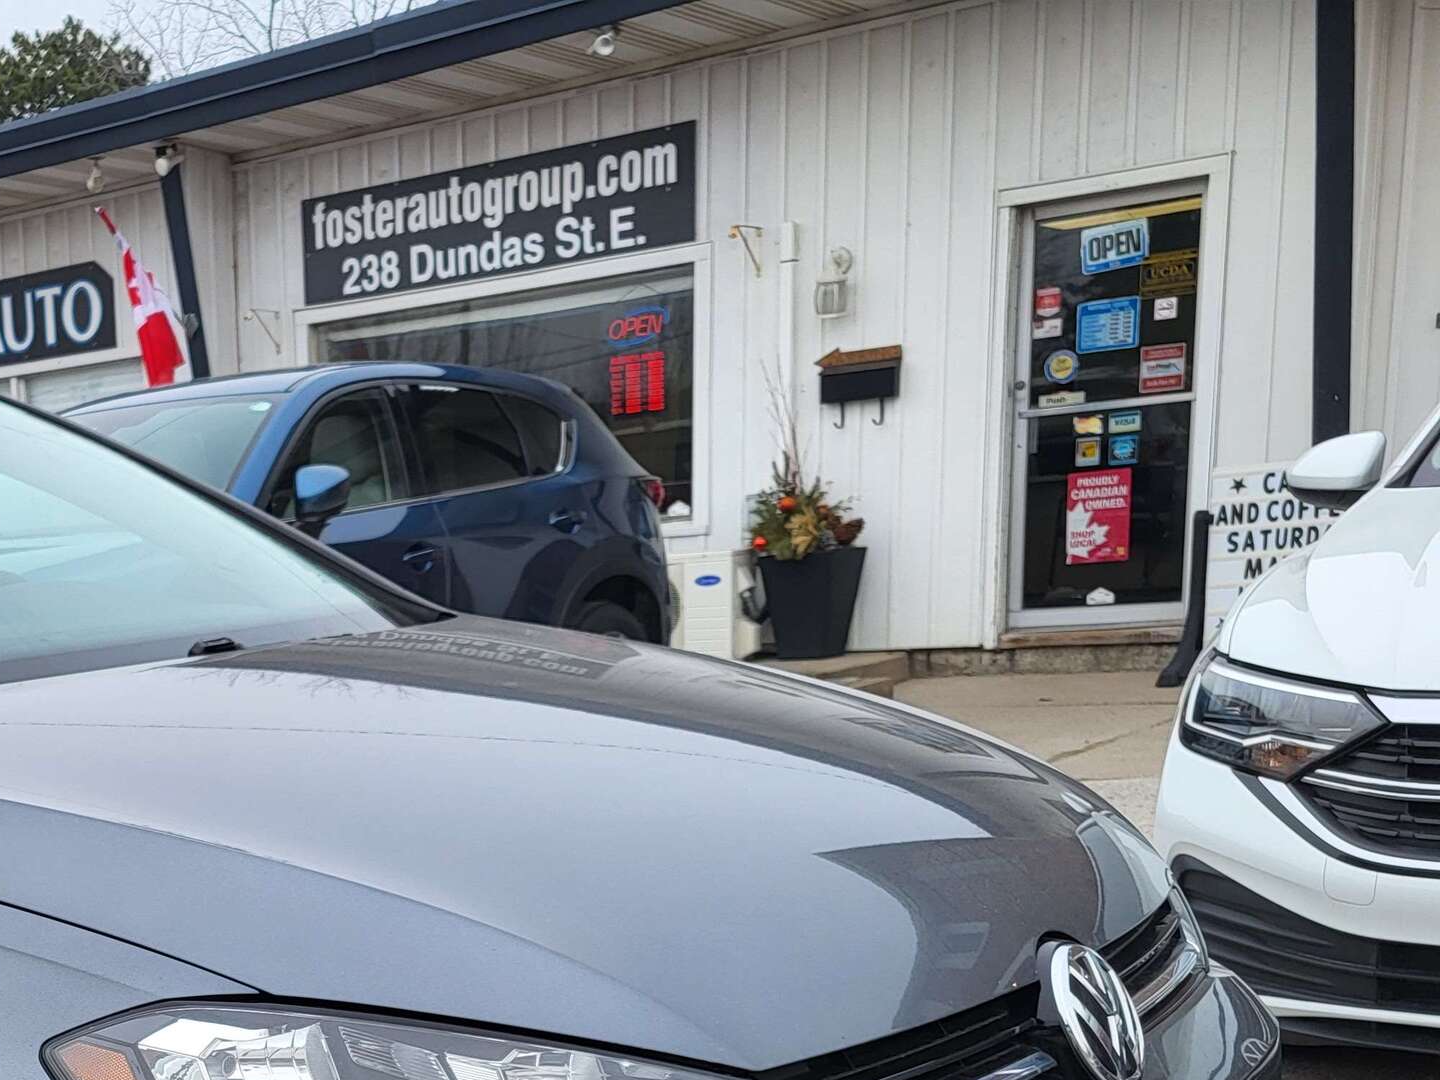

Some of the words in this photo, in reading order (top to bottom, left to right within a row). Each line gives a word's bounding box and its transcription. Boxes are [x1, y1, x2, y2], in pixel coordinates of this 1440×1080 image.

[312, 141, 678, 250] fosterautogroup.com
[1087, 227, 1141, 262] OPEN
[341, 255, 401, 296] 238
[410, 231, 544, 284] Dundas
[608, 313, 663, 340] OPEN
[1071, 485, 1128, 500] CANADIAN
[1216, 503, 1259, 526] AND
[1227, 525, 1332, 553] SATURD
